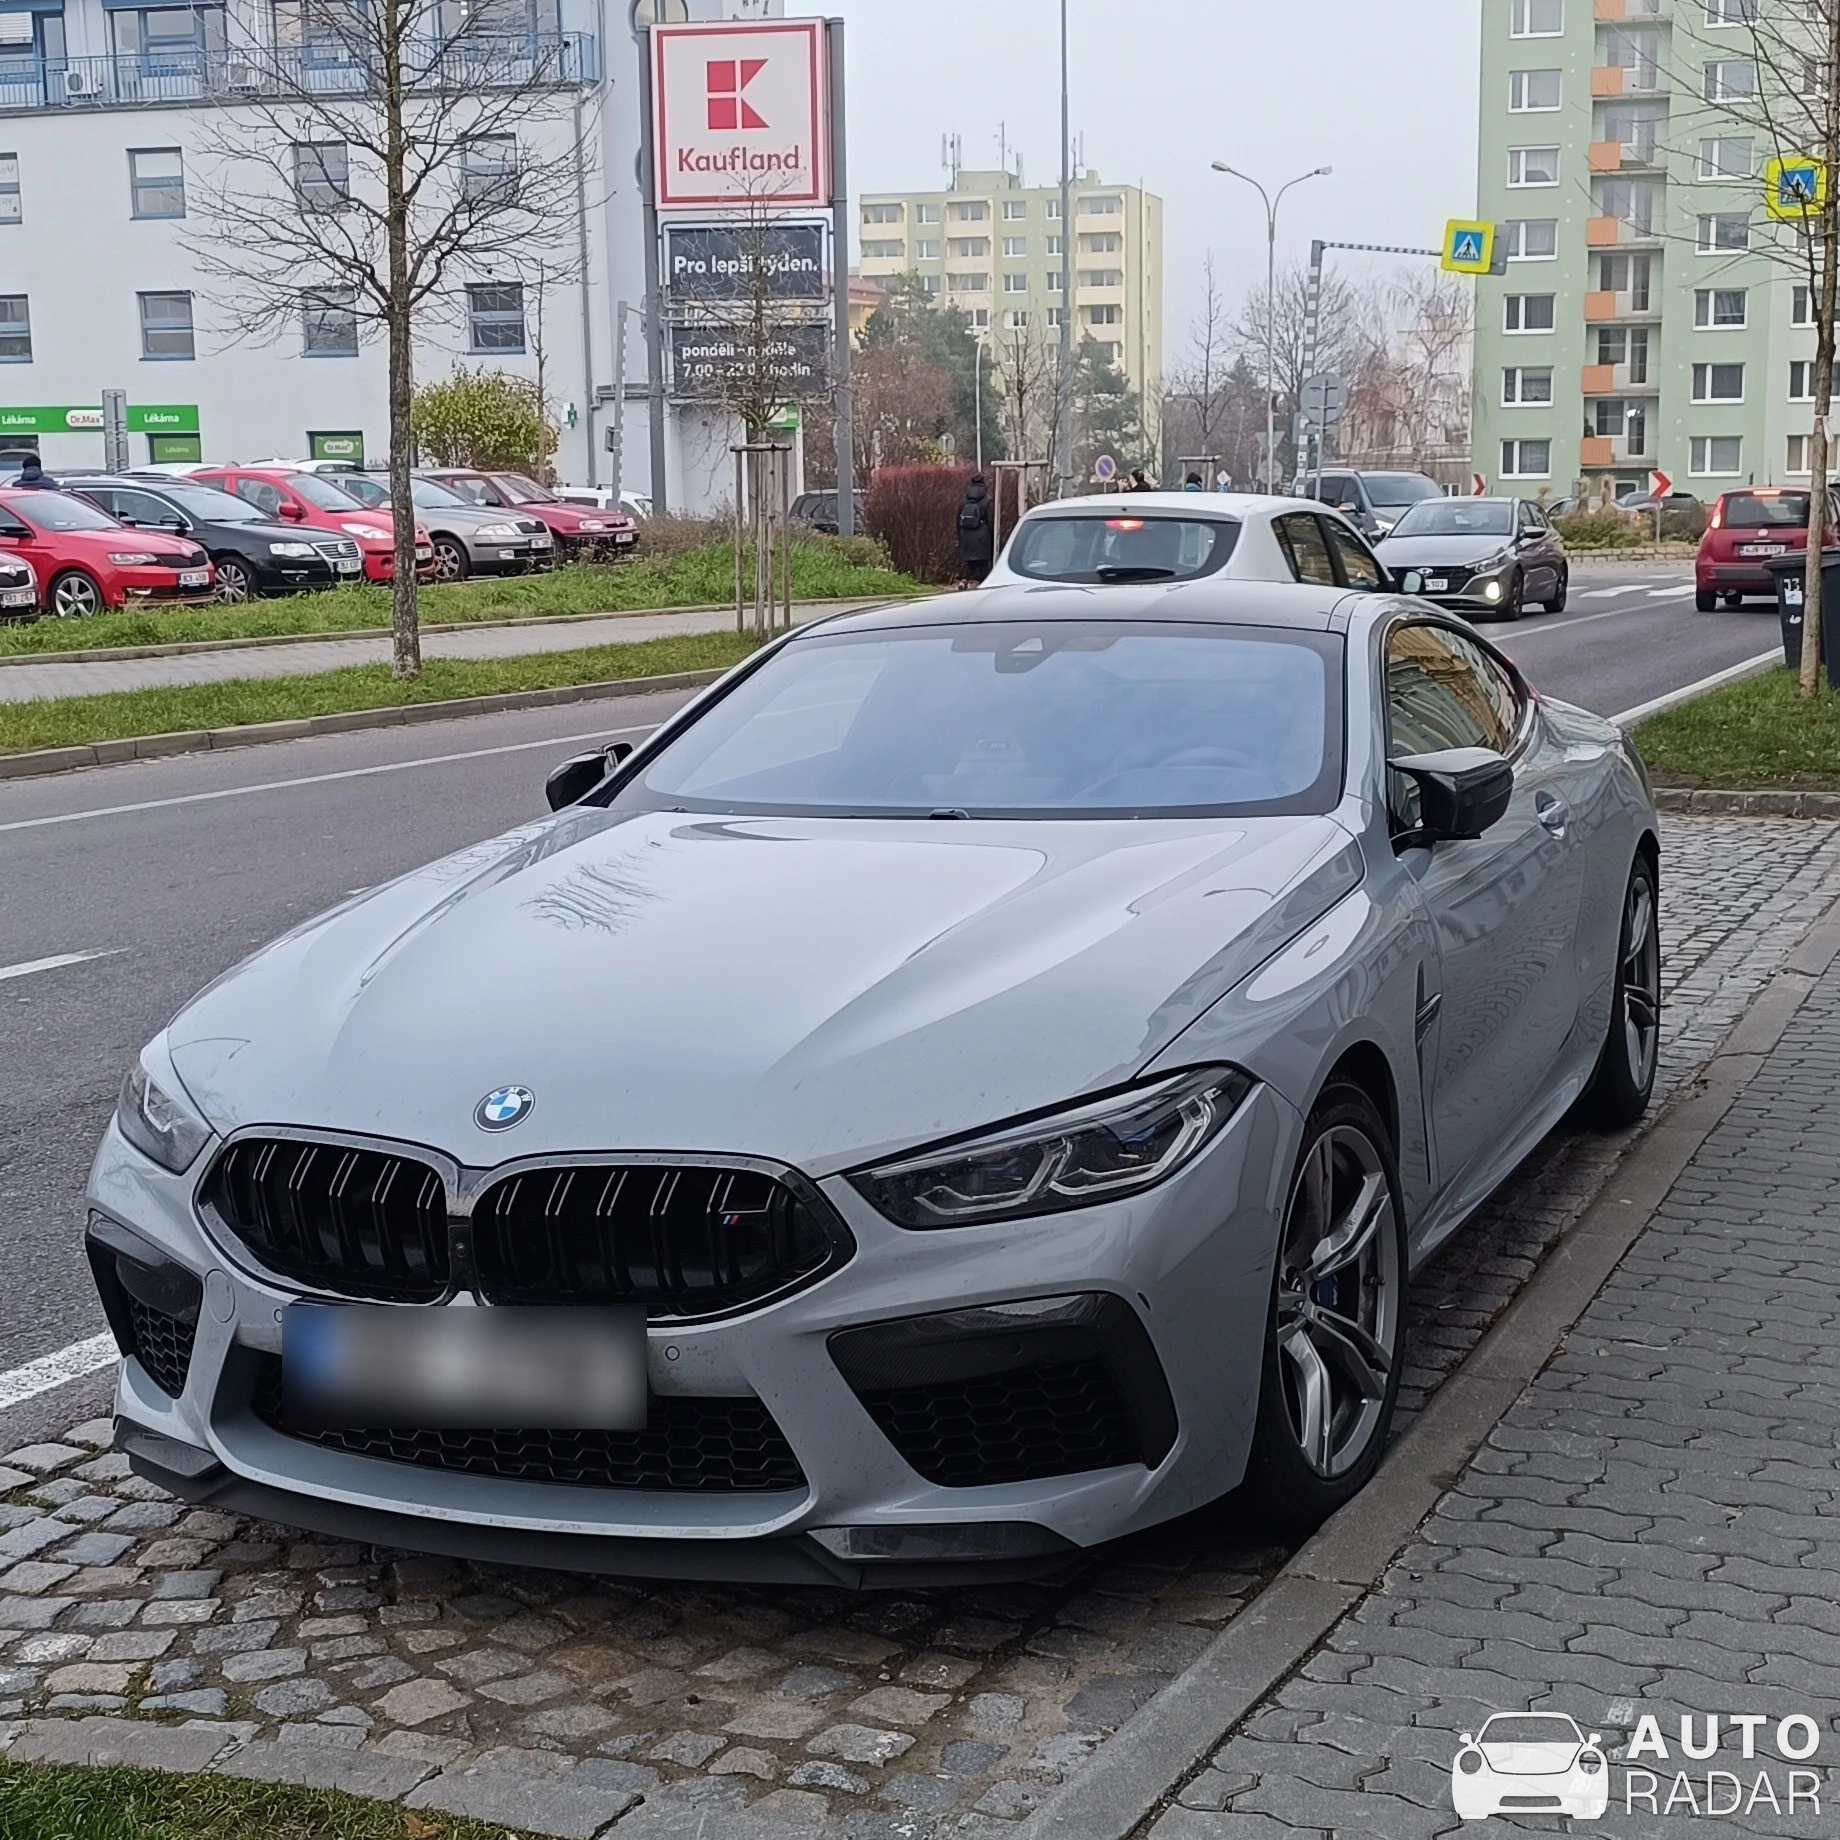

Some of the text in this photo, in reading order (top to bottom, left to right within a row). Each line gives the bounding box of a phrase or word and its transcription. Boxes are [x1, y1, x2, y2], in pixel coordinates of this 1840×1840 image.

[678, 145, 799, 172] Kaufland
[674, 255, 707, 274] Pro
[711, 254, 753, 278] lepší
[2, 414, 37, 425] Lékárna
[70, 414, 101, 424] Dr.Max
[144, 413, 180, 423] Lékárna
[489, 1086, 532, 1102] BMW
